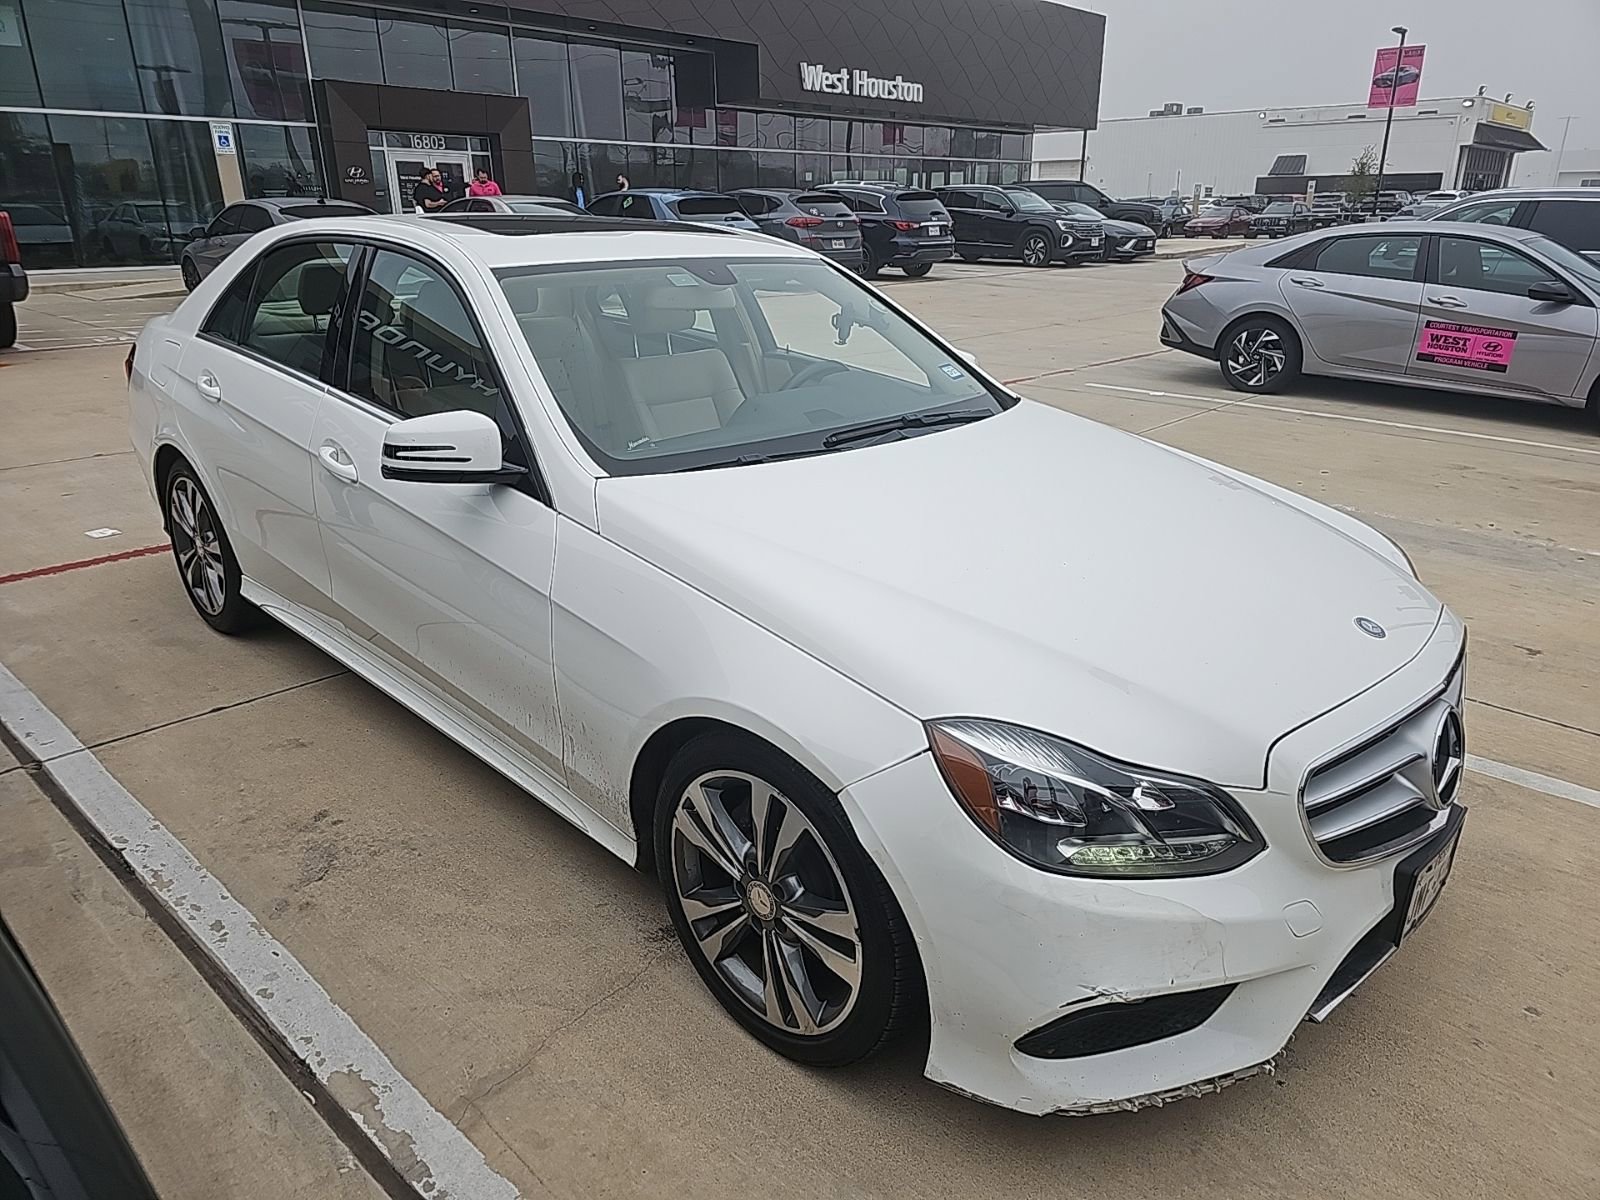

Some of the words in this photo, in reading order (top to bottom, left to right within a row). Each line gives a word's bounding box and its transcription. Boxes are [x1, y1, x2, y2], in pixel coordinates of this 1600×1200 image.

[799, 62, 850, 95] West
[852, 69, 924, 103] Houston
[408, 134, 446, 150] 16803
[1429, 322, 1460, 331] COURTESY
[1461, 325, 1514, 338] TRANSPORTATION
[1429, 333, 1472, 347] WEST
[1426, 342, 1468, 354] HOUSTON
[1433, 356, 1463, 366] PROGRAM
[1463, 360, 1489, 369] VEHICLE
